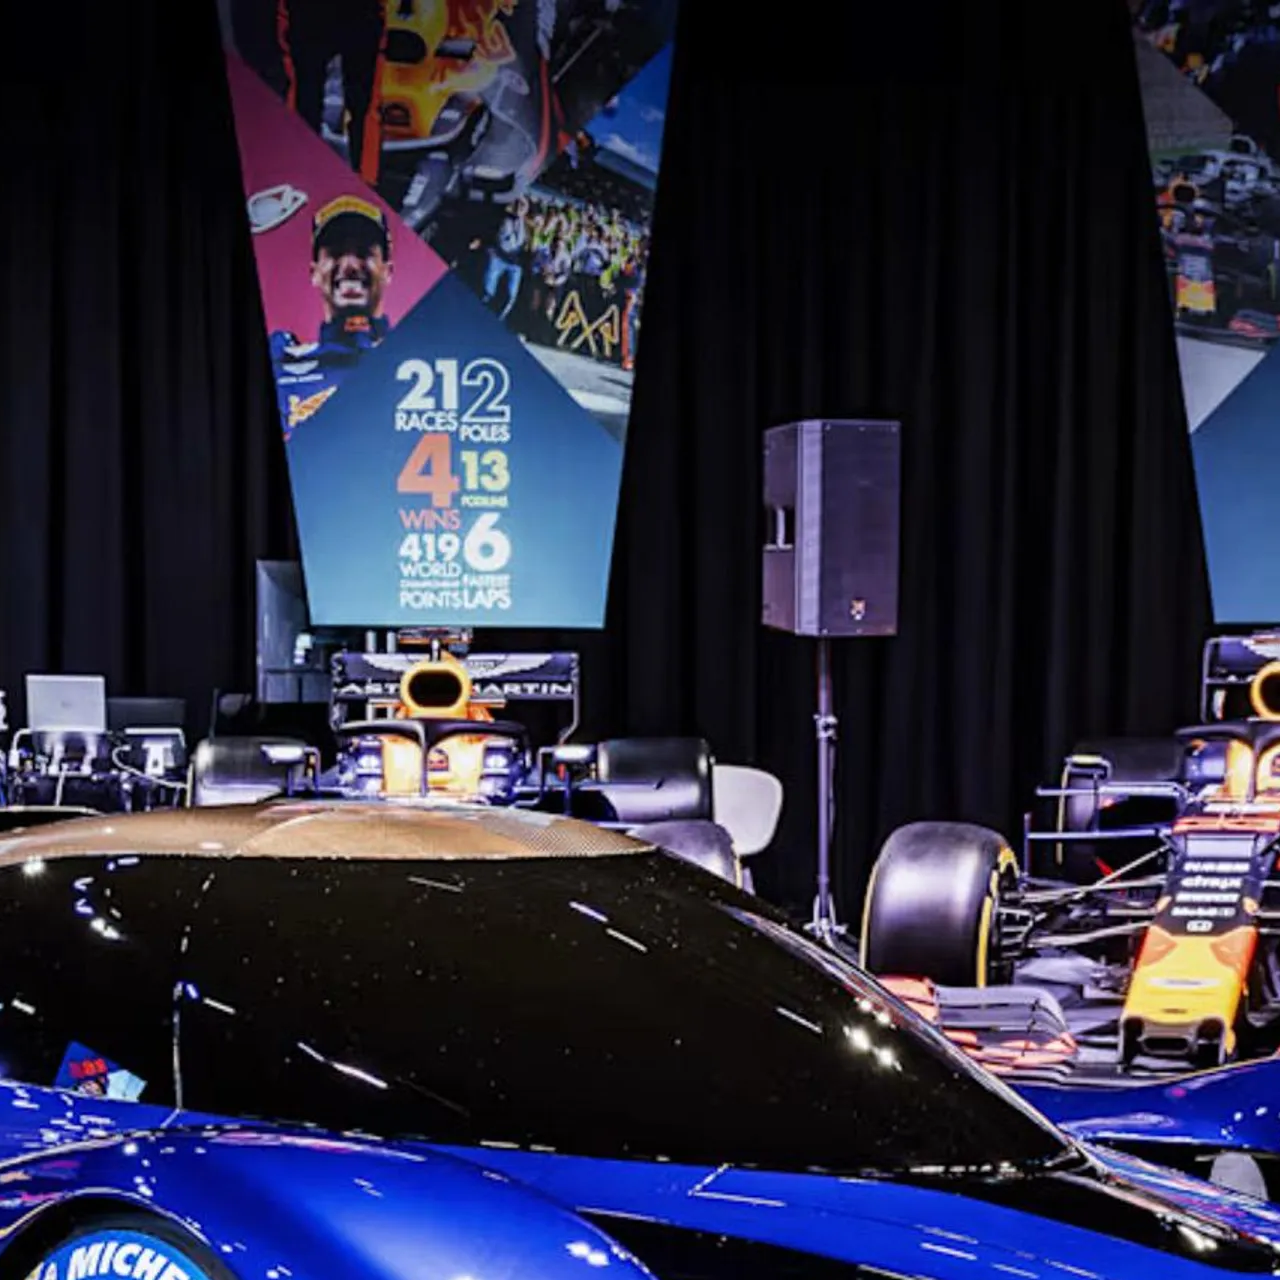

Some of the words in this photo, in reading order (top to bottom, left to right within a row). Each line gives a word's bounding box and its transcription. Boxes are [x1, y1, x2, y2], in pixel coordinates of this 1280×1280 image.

[396, 359, 458, 411] 21
[461, 358, 511, 424] 2
[395, 411, 458, 432] RACES
[460, 424, 510, 442] POLES
[396, 433, 460, 508] 4
[460, 450, 510, 491] 13
[399, 509, 460, 530] WINS
[399, 533, 460, 562] 419
[463, 512, 511, 572] 6
[400, 562, 462, 578] WORLD
[400, 590, 462, 609] POINTS
[463, 587, 512, 609] LAPS
[340, 682, 401, 695] AST
